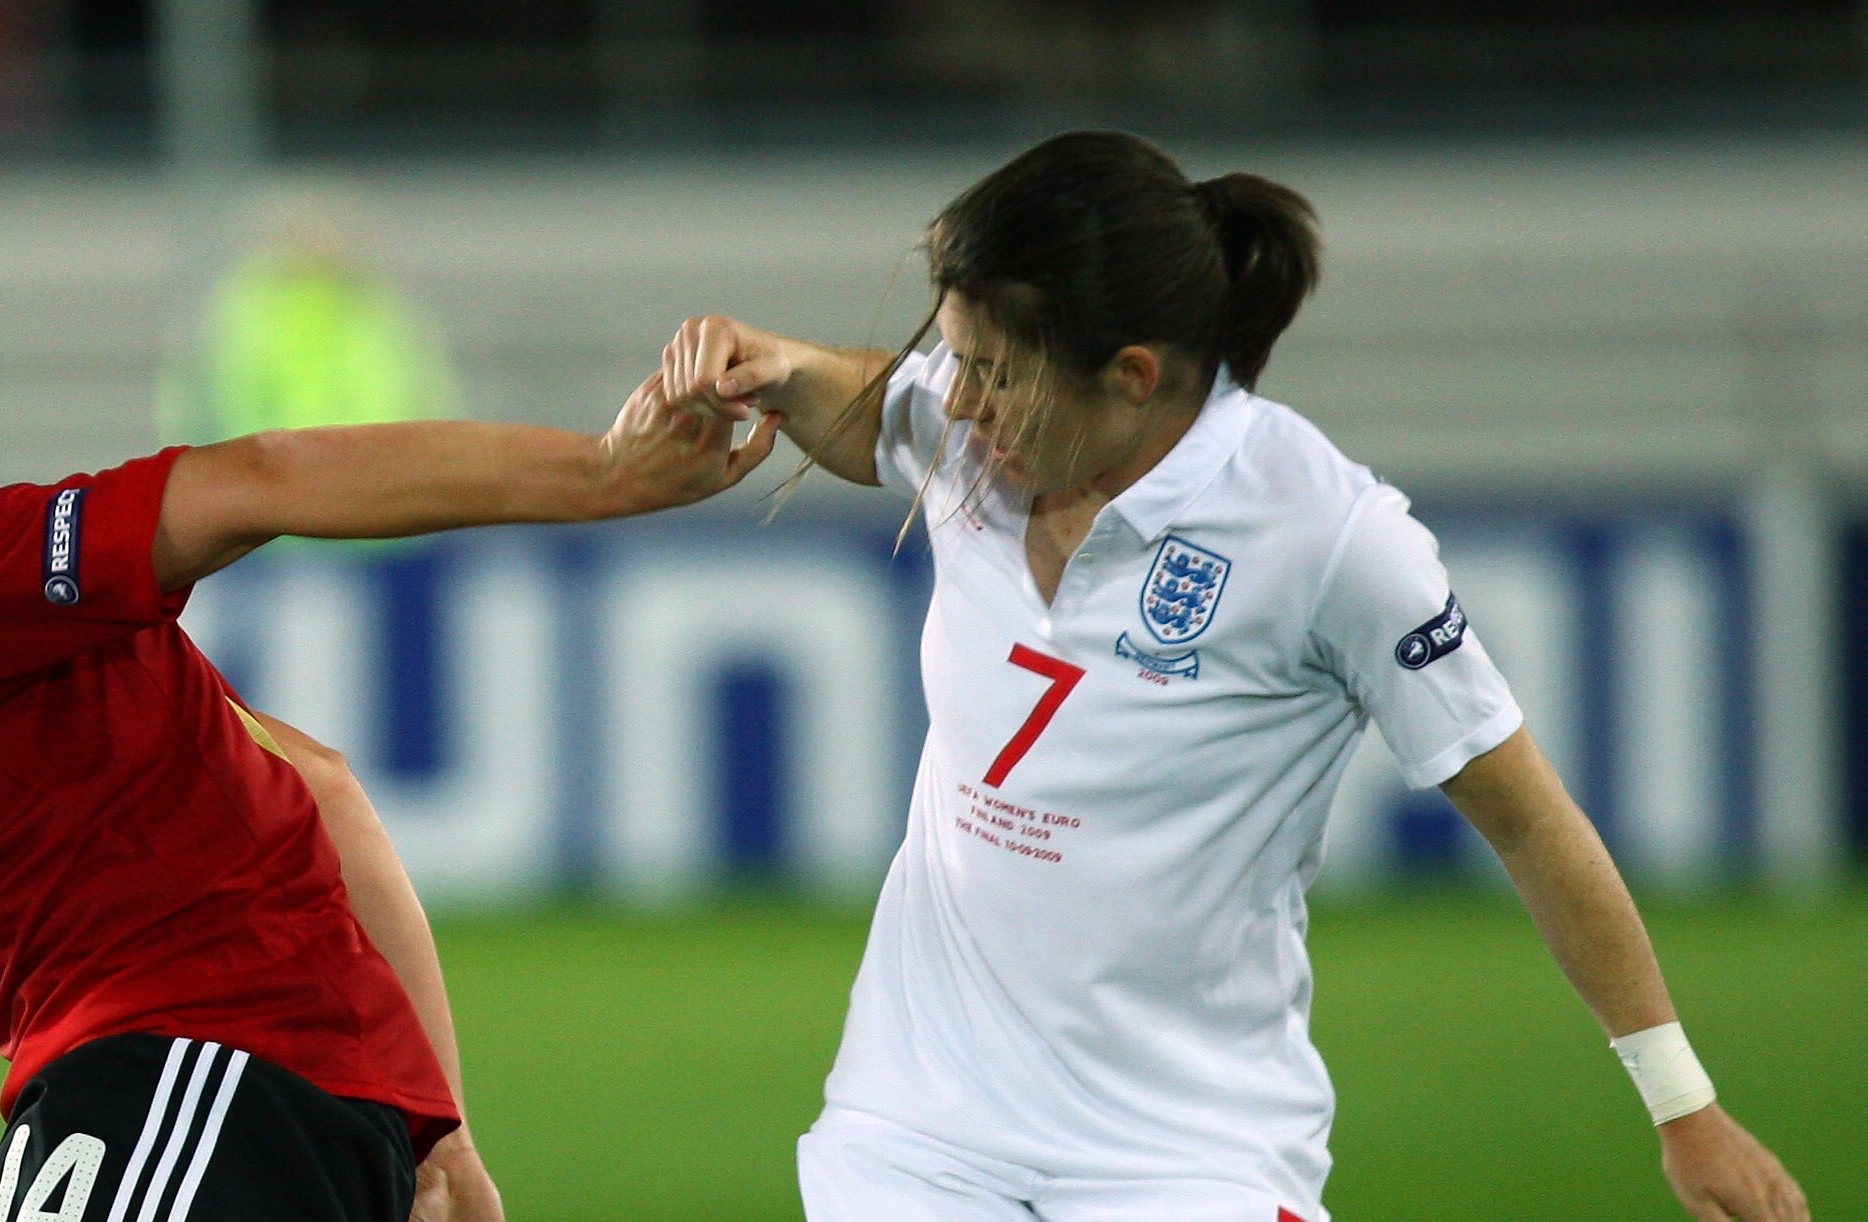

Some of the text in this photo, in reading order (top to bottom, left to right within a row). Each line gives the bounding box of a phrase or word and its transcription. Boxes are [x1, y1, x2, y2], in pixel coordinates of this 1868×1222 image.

[982, 642, 1087, 788] 7
[983, 795, 1037, 822] WOMEN'S
[1041, 812, 1082, 829] EURO
[1020, 824, 1052, 841] 2009
